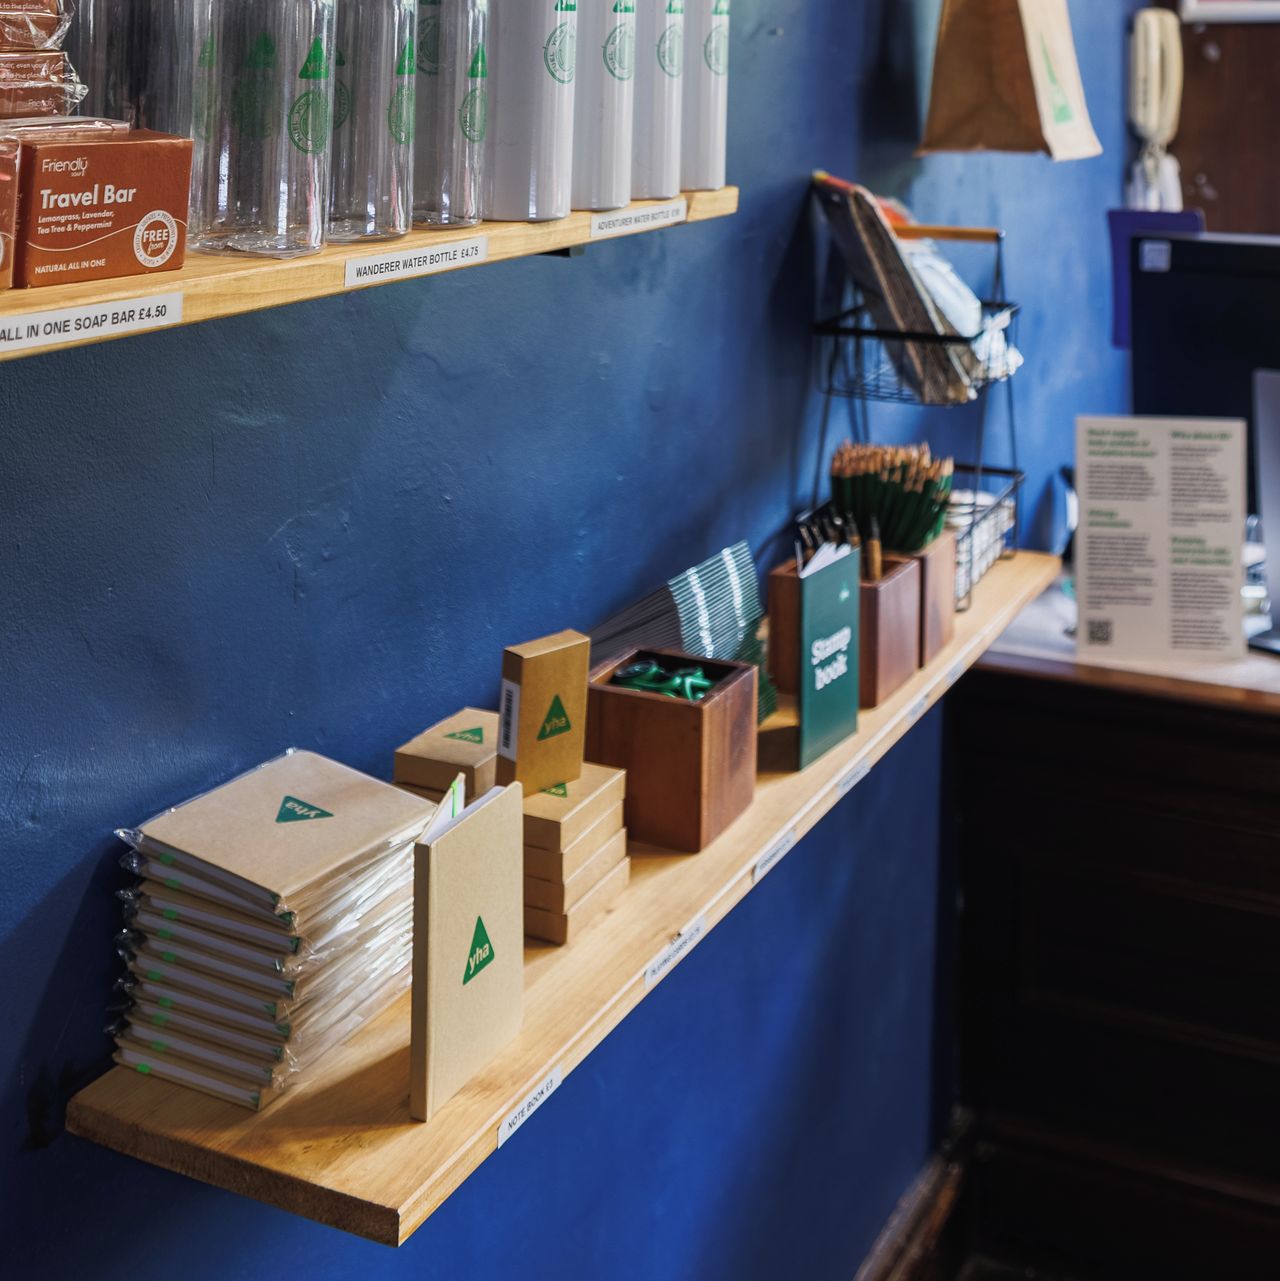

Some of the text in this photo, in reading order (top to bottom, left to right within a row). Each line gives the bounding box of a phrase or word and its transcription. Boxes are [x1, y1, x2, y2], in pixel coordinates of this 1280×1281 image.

[40, 184, 136, 209] Travel Bar
[38, 210, 115, 223] Lemongrass, Lavender,
[37, 227, 50, 235] Tea
[51, 224, 65, 232] Tree
[74, 221, 112, 233] Peppermint
[143, 229, 169, 242] FREE
[147, 242, 164, 255] from
[35, 259, 105, 274] NATURAL ALL IN ONE
[356, 246, 479, 278] WANDERER WATER BOTTLE £4.75
[27, 324, 39, 338] IN
[43, 319, 71, 336] ONE
[74, 314, 108, 331] SOAP
[111, 309, 135, 325] BAR
[138, 304, 167, 320] £4.50
[811, 626, 851, 666] Stamp
[815, 653, 847, 690] book
[455, 731, 481, 742] yha
[544, 716, 566, 737] yha
[285, 800, 318, 819] yha
[468, 941, 489, 975] yha
[508, 1107, 526, 1131] NOTE
[526, 1089, 545, 1113] BOOK
